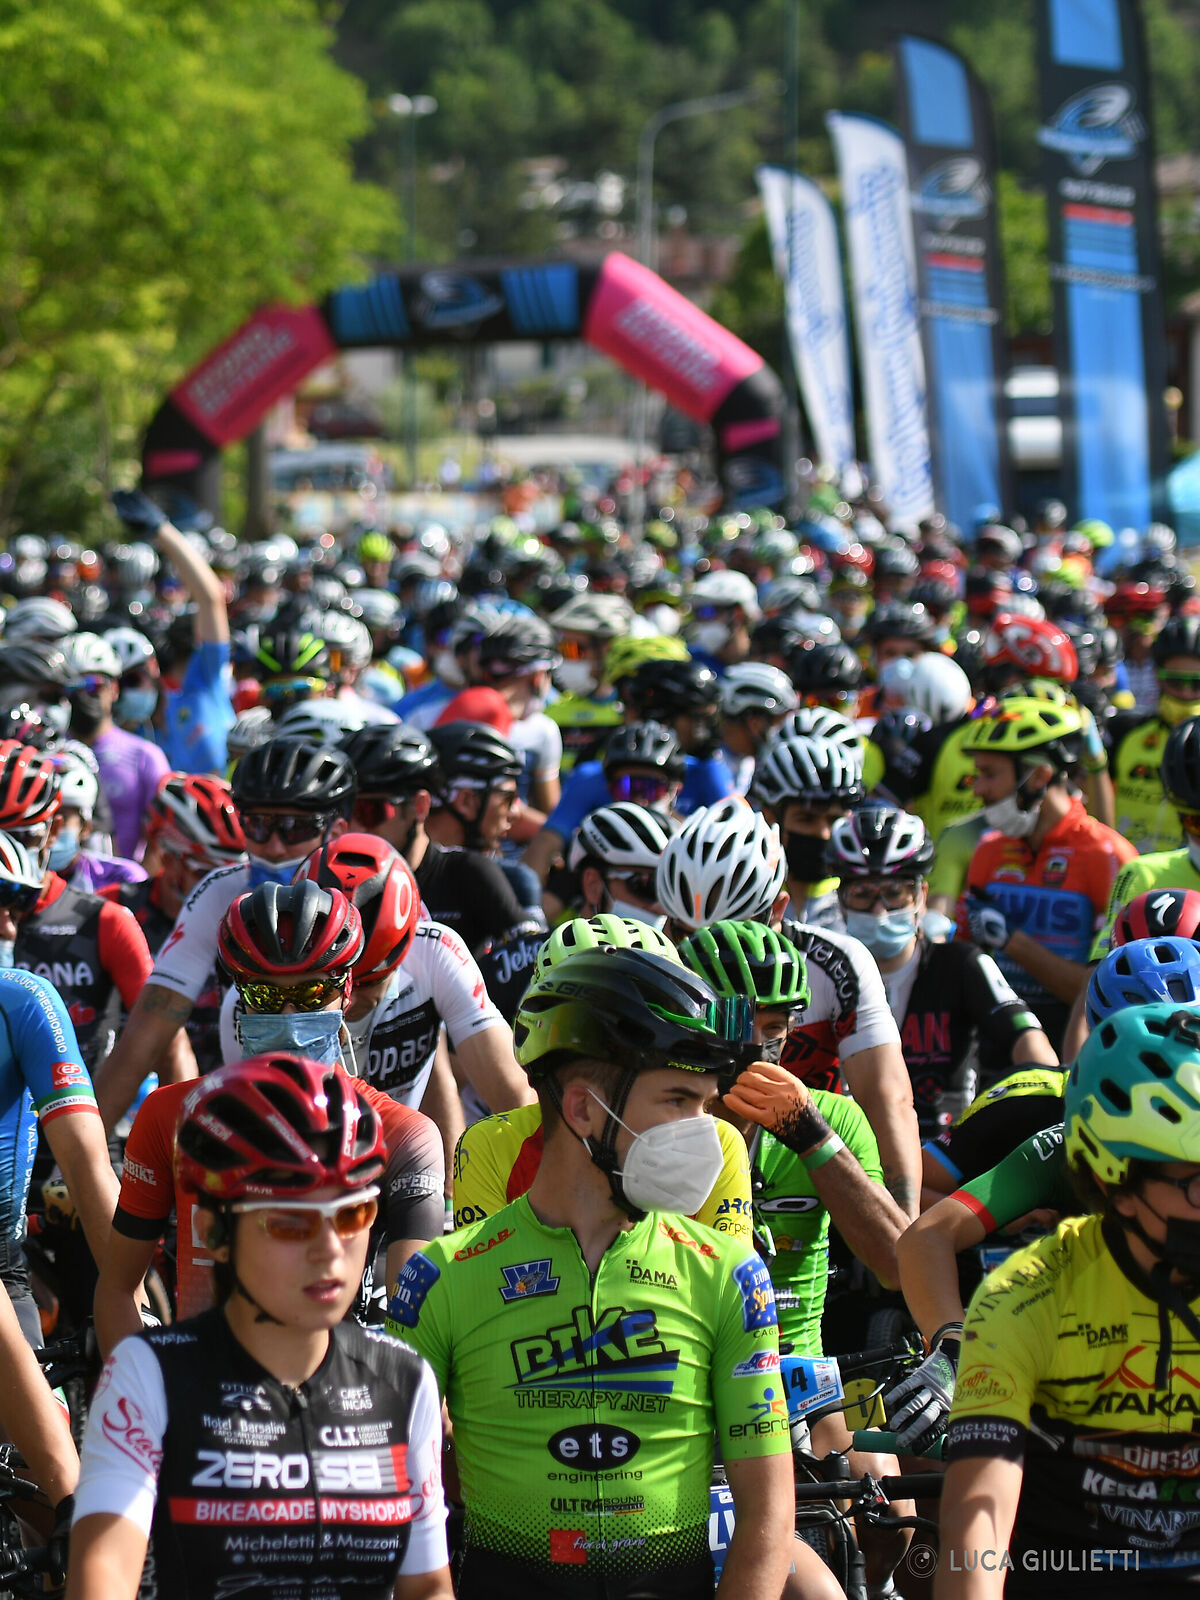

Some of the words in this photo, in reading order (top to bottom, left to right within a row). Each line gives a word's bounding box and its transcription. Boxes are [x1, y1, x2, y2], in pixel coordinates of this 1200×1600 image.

[2, 971, 15, 981] DE
[14, 974, 38, 993] LUCA
[35, 989, 68, 1055] PIERGIORGIO
[27, 1122, 38, 1164] VALLE
[629, 1266, 678, 1286] DAMA
[510, 1304, 667, 1384] BIKE
[341, 1398, 373, 1411] INCAS
[514, 1389, 670, 1413] THERAPY.NET
[203, 1415, 232, 1431] Hotel
[240, 1418, 287, 1436] Barsalini
[559, 1432, 629, 1459] ets
[191, 1449, 311, 1490] ZERO
[547, 1470, 643, 1484] engineering
[224, 1535, 315, 1551] Micheletti
[323, 1535, 334, 1549] &
[336, 1535, 401, 1550] Mazzoni
